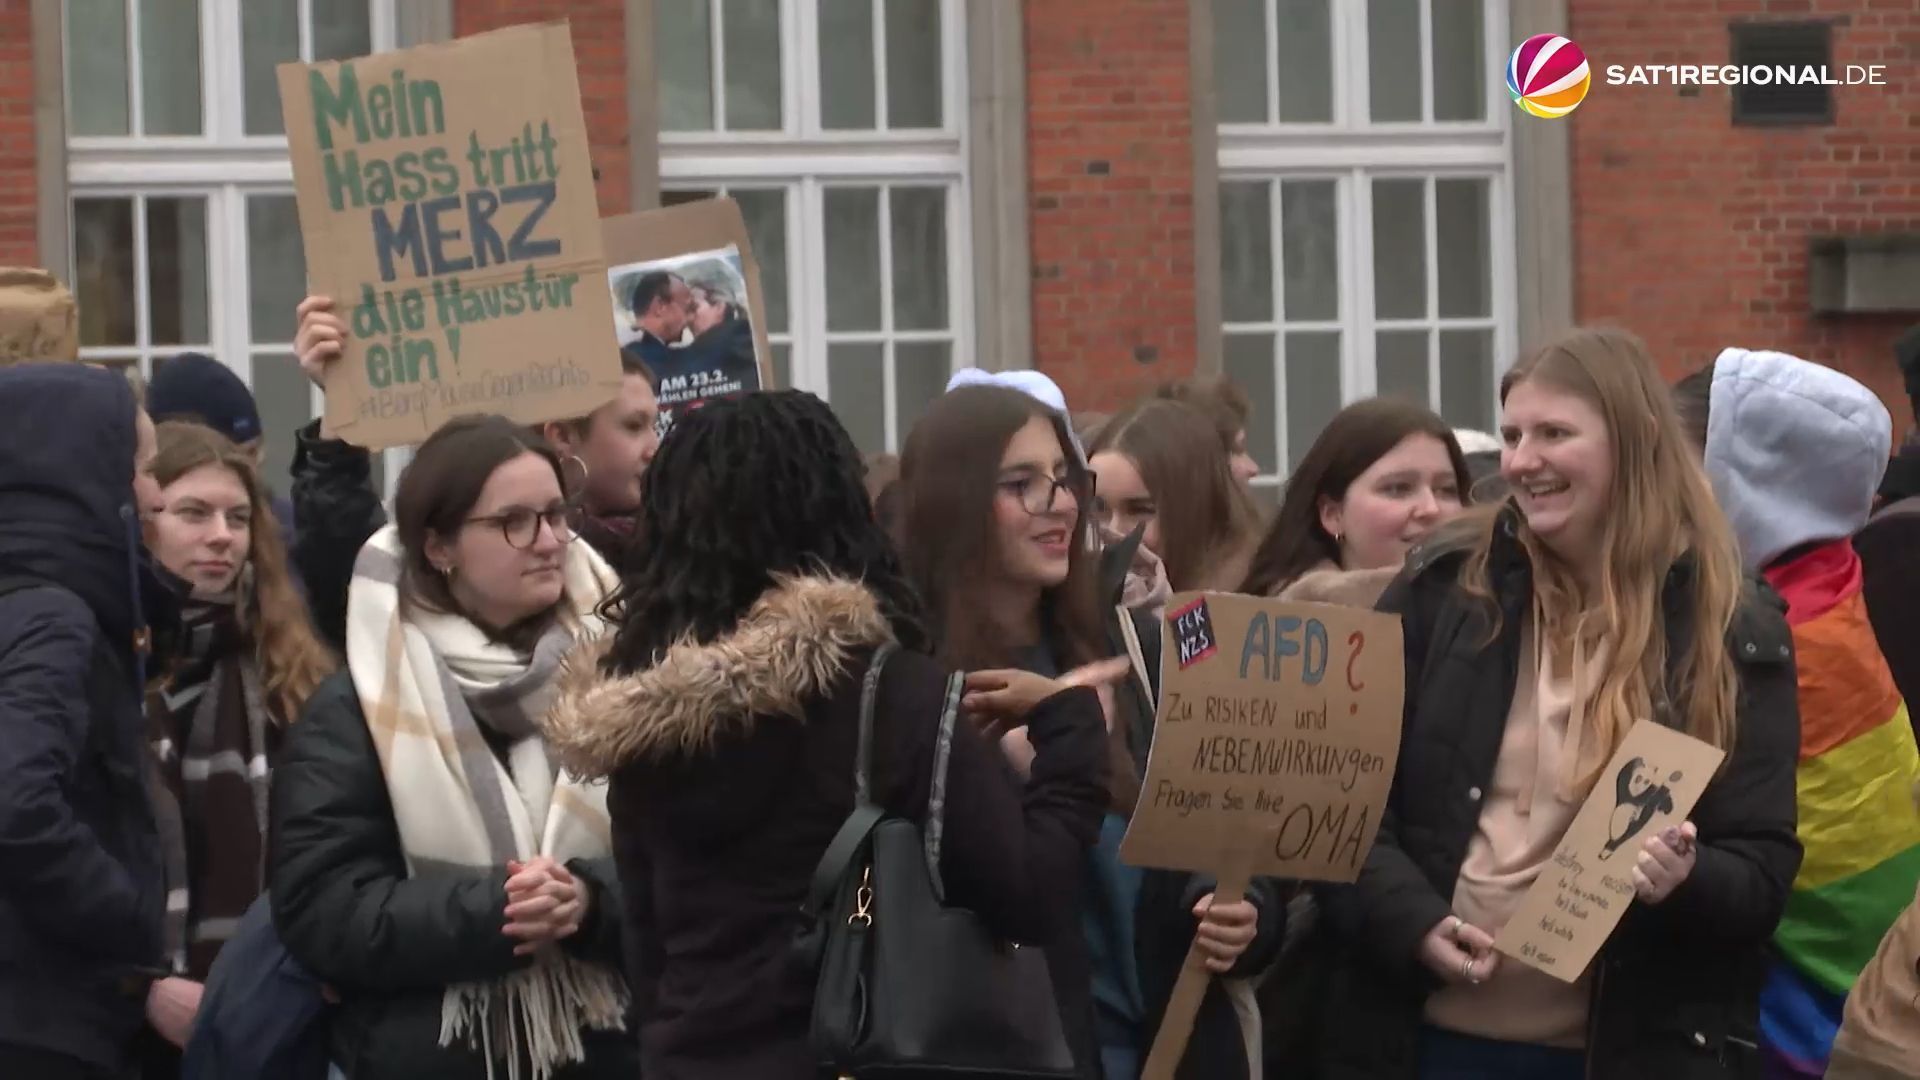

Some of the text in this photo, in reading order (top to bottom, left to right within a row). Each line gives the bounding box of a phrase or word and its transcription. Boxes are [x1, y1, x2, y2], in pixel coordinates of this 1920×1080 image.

[308, 64, 446, 151] Mein
[323, 118, 559, 212] Hass tritt
[371, 181, 561, 282] MERZ
[352, 263, 579, 340] die Haustür
[660, 377, 687, 392] AM
[1177, 607, 1205, 637] FCK
[1180, 630, 1209, 665] NZS
[1239, 611, 1365, 716] AFD ?
[1165, 693, 1327, 730] Zu RISIKEN und
[1153, 779, 1212, 818] Fragen
[1275, 803, 1369, 868] OMA
